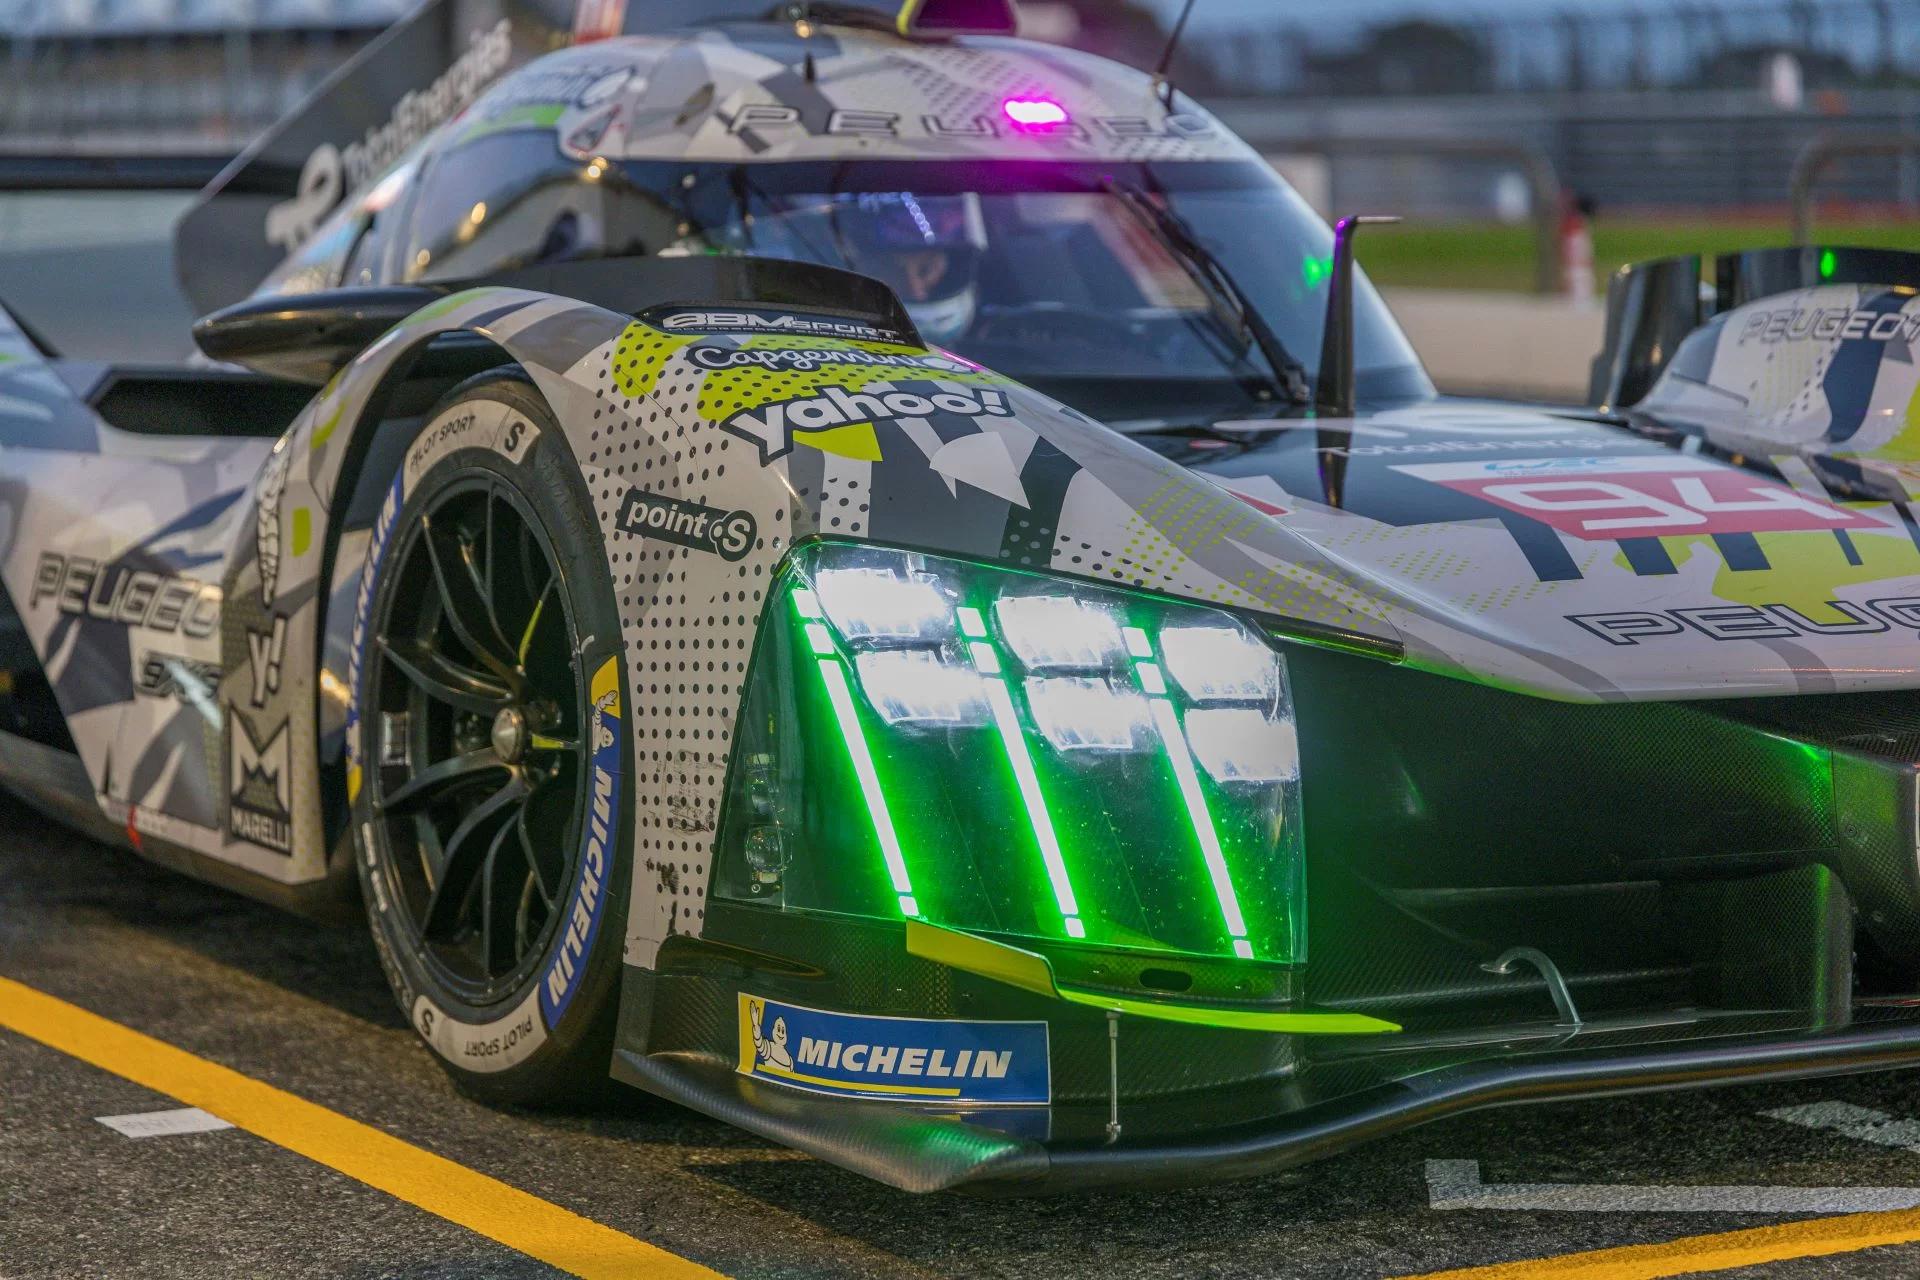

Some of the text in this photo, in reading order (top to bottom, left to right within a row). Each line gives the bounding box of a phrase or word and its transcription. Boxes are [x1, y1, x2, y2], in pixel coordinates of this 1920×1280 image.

[693, 347, 925, 372] Capgemini
[438, 415, 476, 442] SPORT
[504, 421, 526, 452] S
[626, 501, 709, 538] point
[1482, 476, 1856, 532] 94
[230, 806, 291, 850] MARELLI
[547, 765, 614, 1007] MICHELIN
[419, 1008, 435, 1038] S
[463, 1015, 533, 1058] PILOT SPORT
[797, 1036, 1013, 1078] MICHELIN
